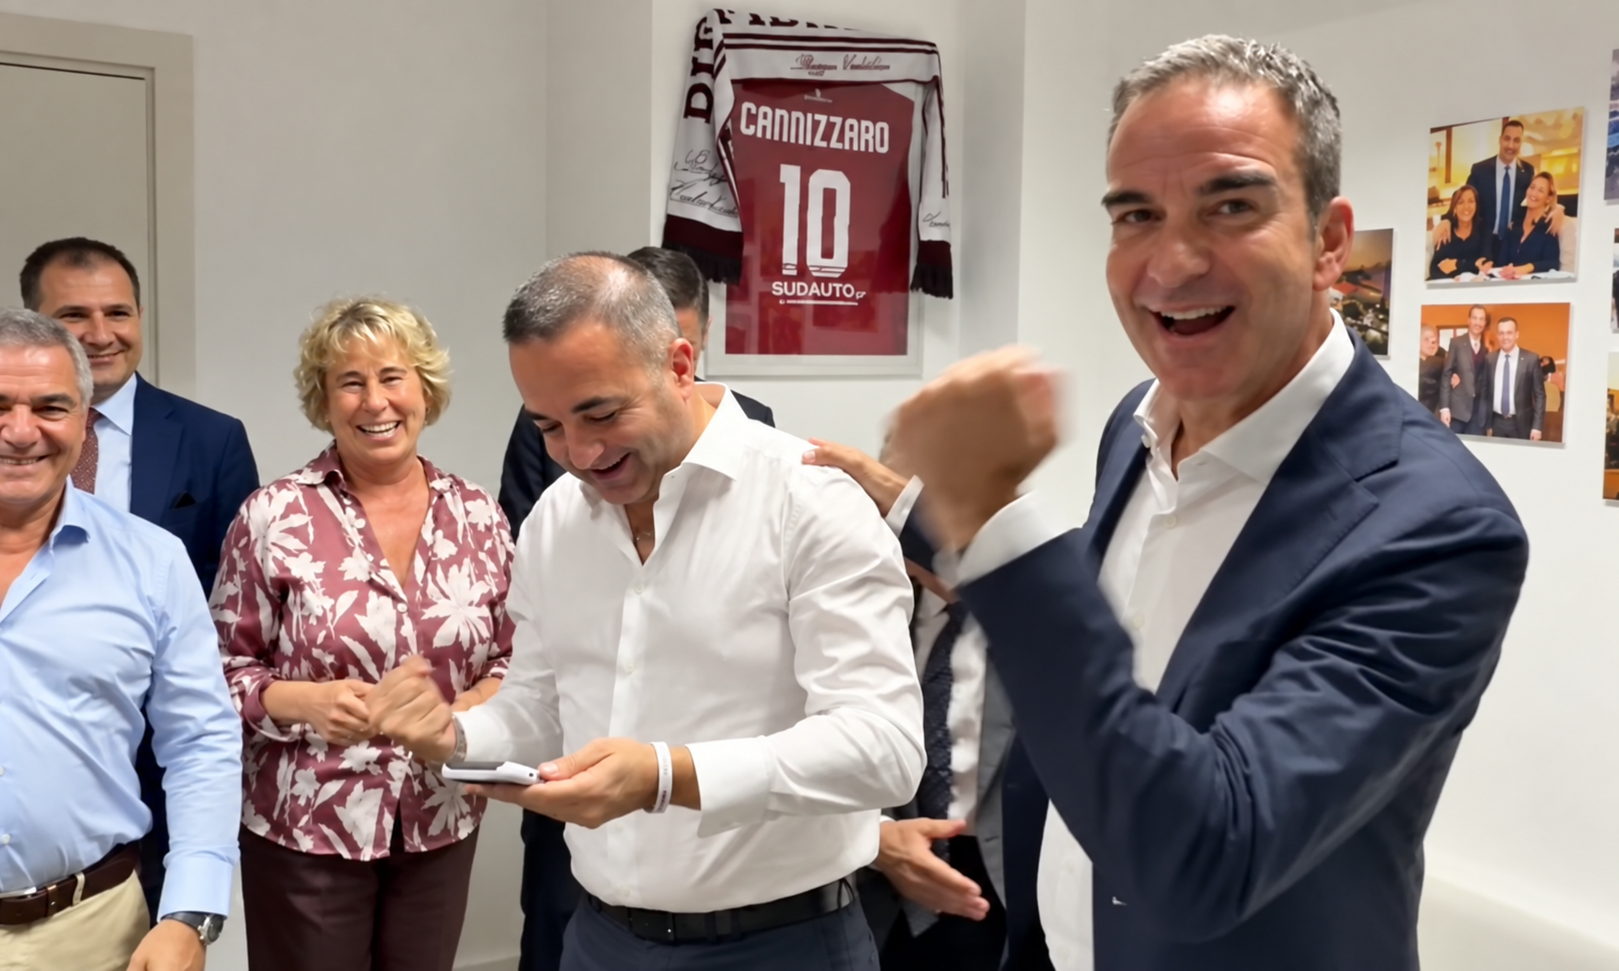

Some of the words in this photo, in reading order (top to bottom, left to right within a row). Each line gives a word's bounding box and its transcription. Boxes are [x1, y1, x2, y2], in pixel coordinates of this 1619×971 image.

[740, 101, 889, 154] CANNIZZARO
[779, 163, 851, 278] 10
[771, 281, 855, 298] SUDAUTO
